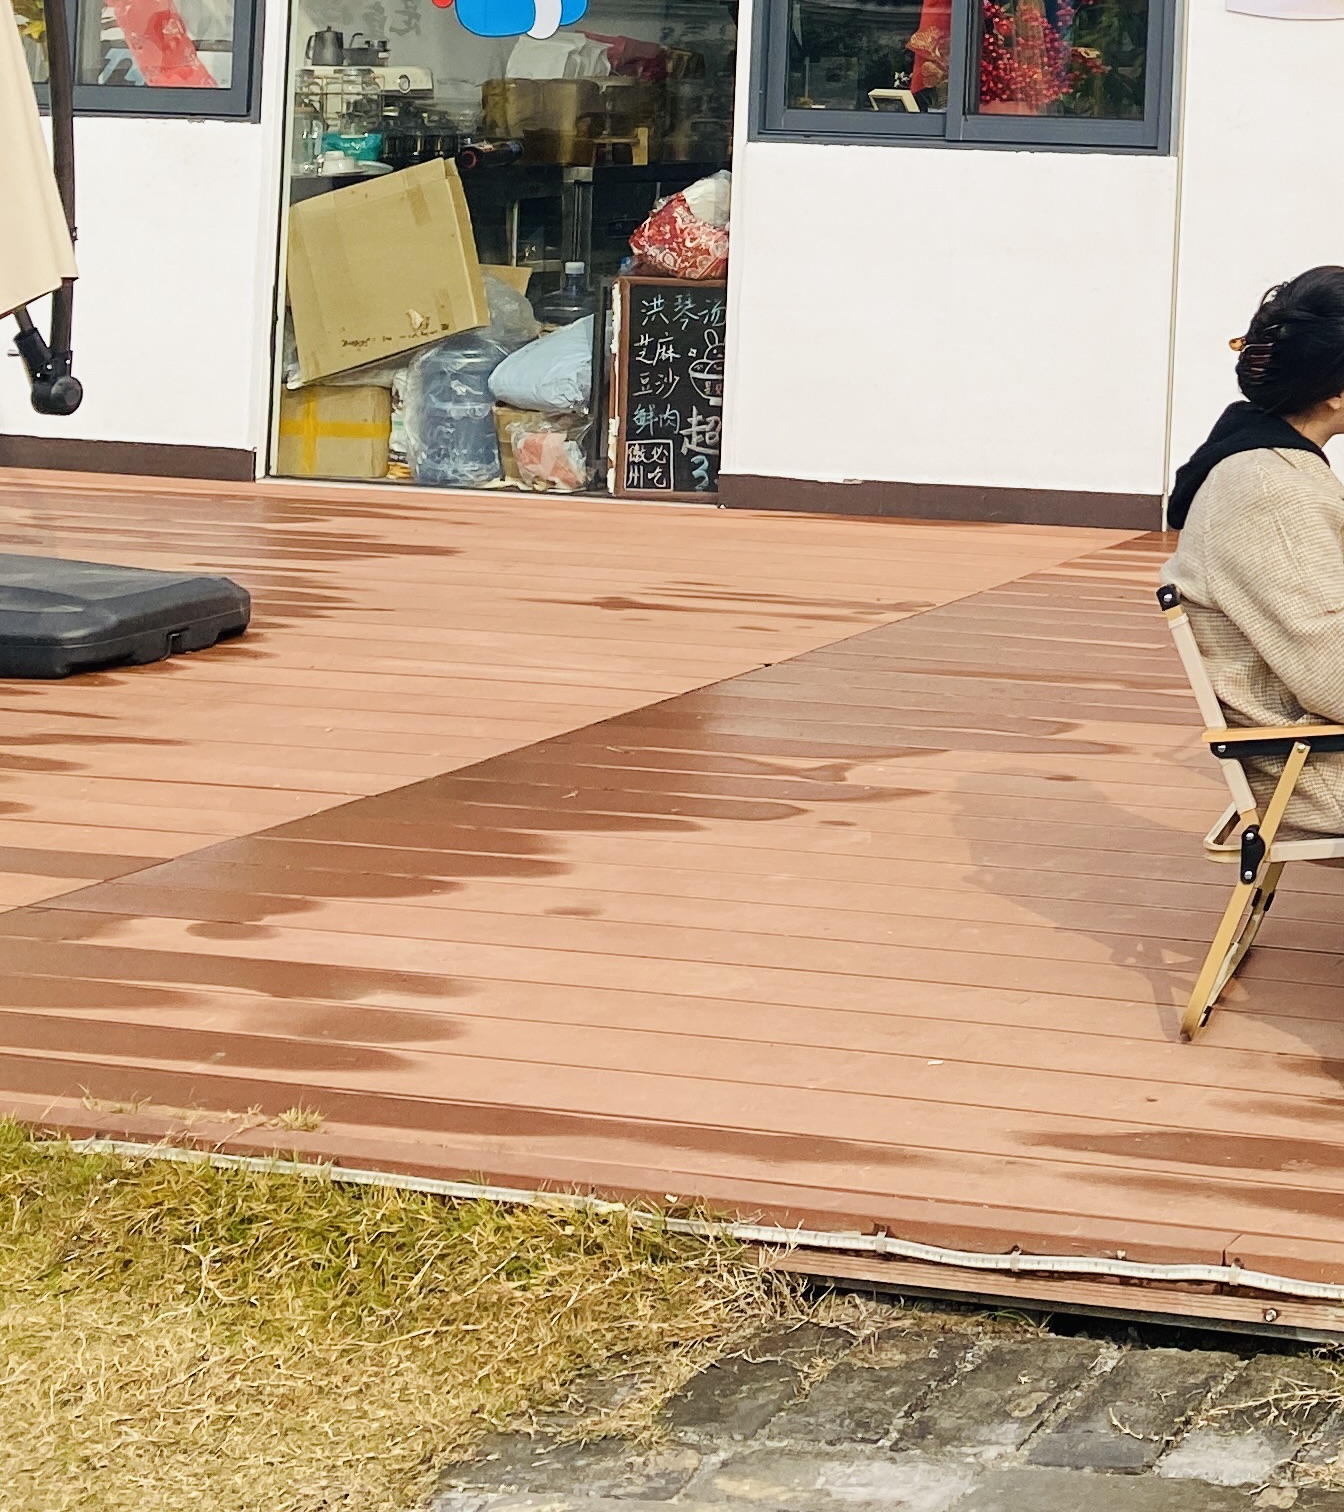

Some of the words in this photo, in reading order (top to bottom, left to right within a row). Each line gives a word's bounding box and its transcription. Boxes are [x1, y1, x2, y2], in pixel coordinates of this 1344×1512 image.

[634, 332, 681, 366] 芝麻
[632, 367, 680, 399] 豆沙
[632, 402, 680, 436] 鲜肉
[679, 405, 722, 456] 超
